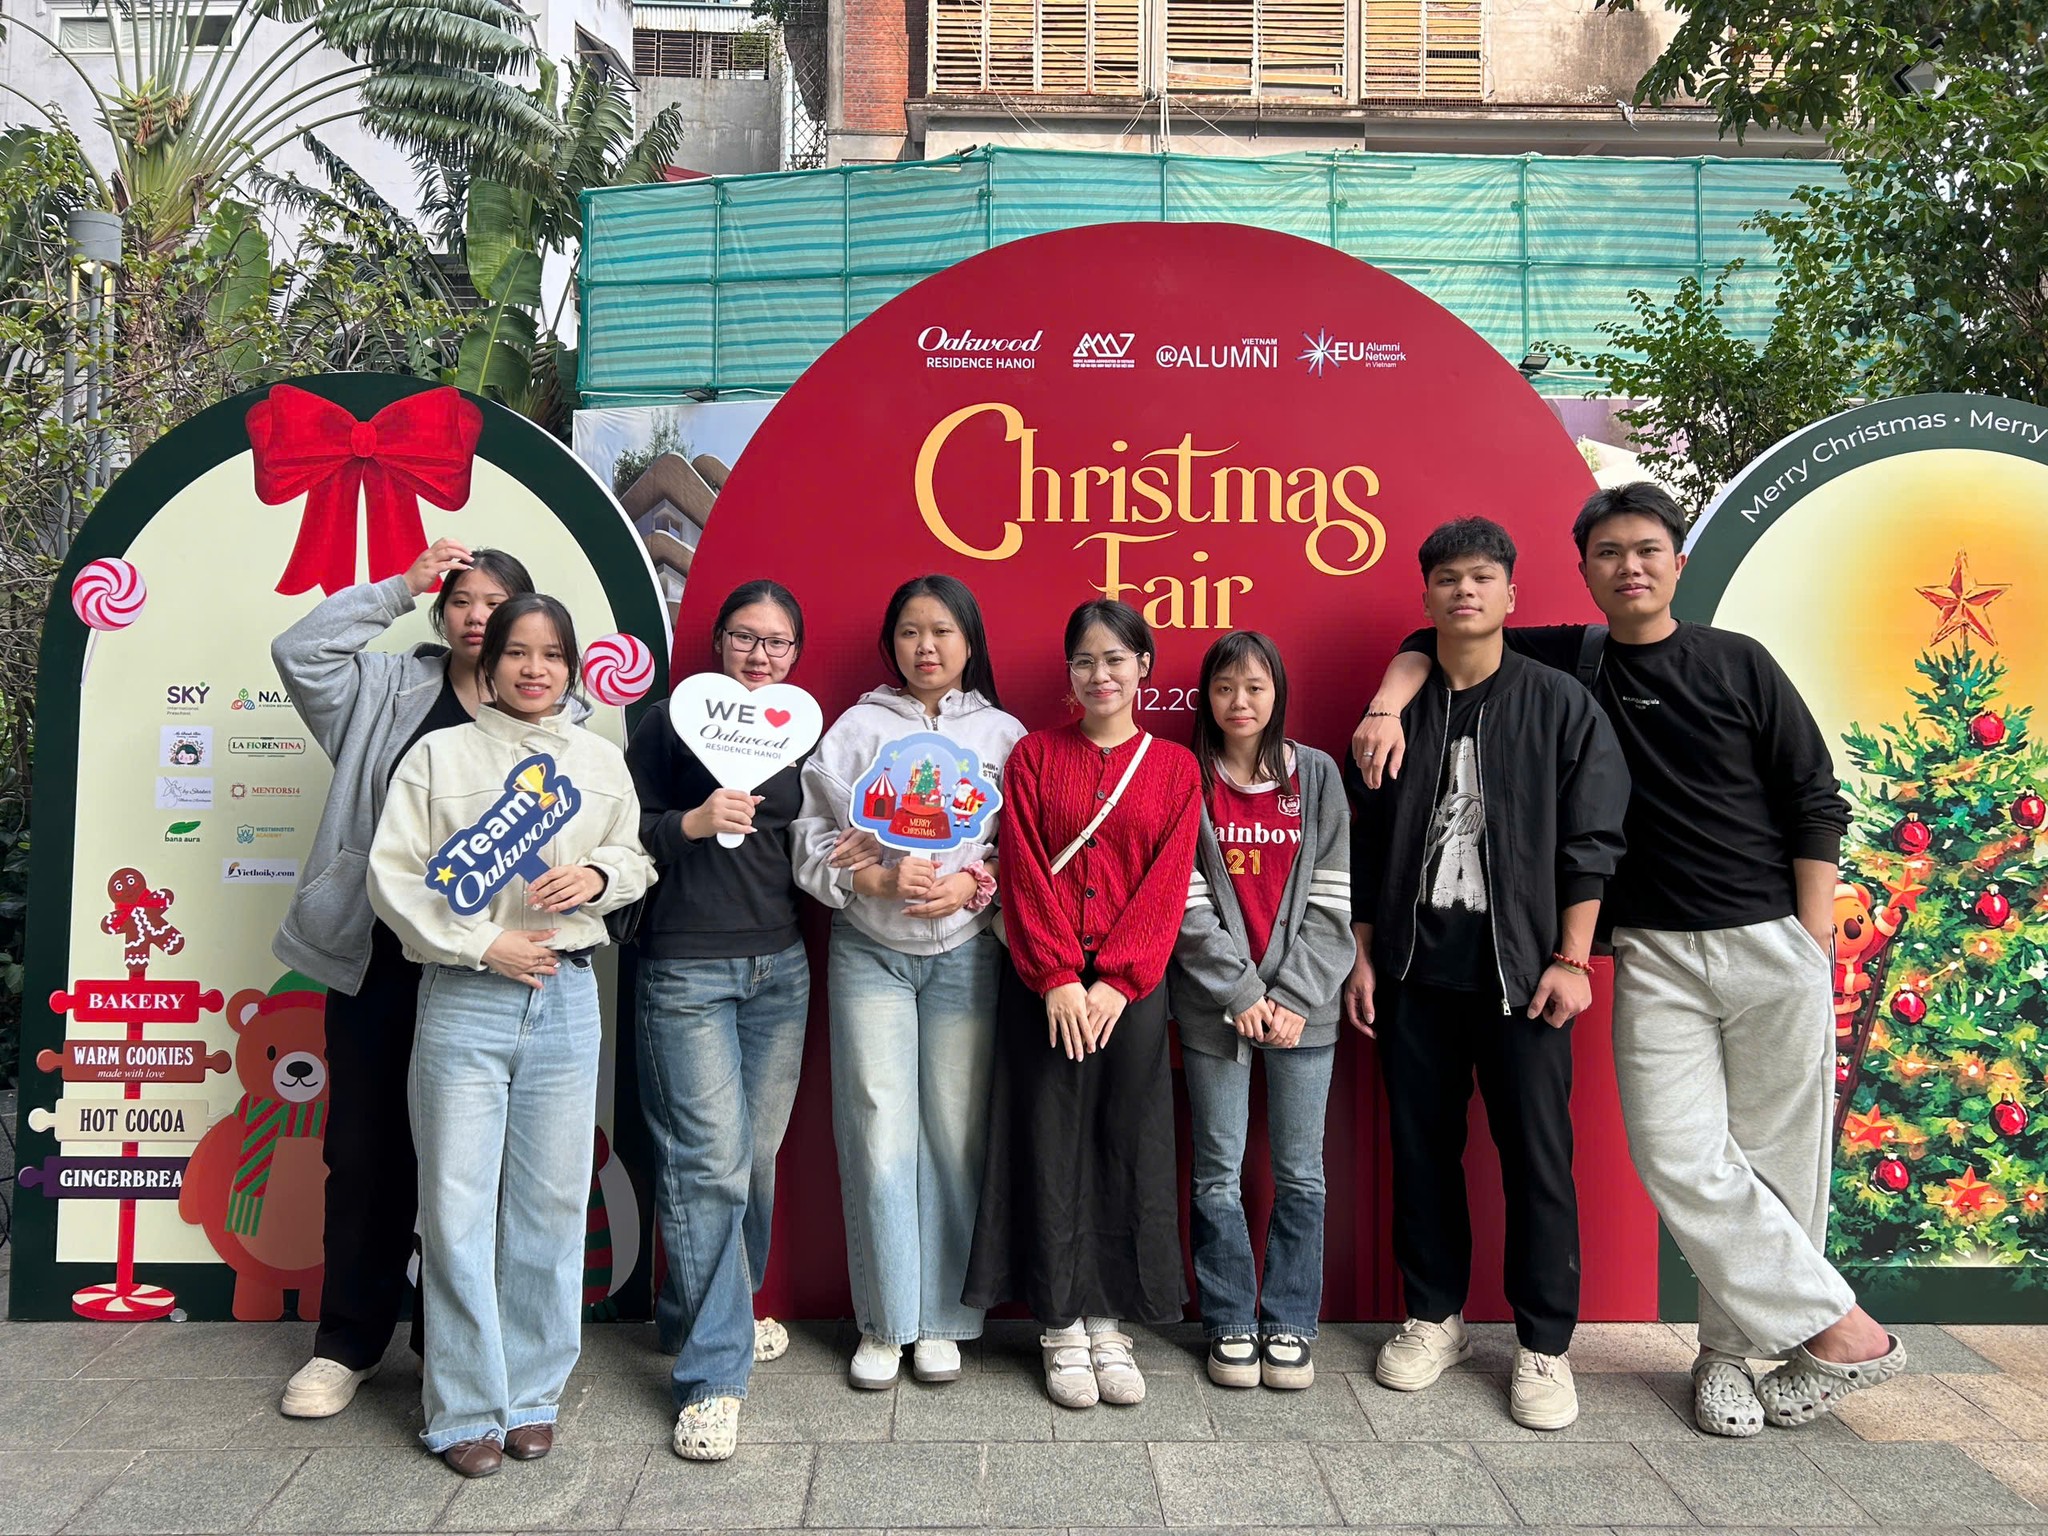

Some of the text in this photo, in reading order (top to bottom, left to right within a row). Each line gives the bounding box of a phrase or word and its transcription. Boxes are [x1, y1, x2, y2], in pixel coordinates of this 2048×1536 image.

[917, 326, 1043, 352] Oakwood
[1366, 342, 1400, 352] Alumni
[1334, 341, 1364, 361] EU
[1365, 351, 1407, 361] Network
[926, 357, 1035, 369] RESIDENCE HANOI
[1969, 408, 2048, 445] Merry
[1740, 412, 1947, 524] Merry Christmas
[914, 402, 1387, 576] Christmas
[1072, 530, 1254, 630] Fair
[166, 682, 211, 705] SKY
[705, 699, 757, 725] WE
[232, 741, 302, 750] LA FIORENTINA
[700, 724, 790, 750] Oakwood
[705, 742, 782, 760] RESIDENCE HANOI
[252, 787, 301, 795] MENTORS14
[446, 791, 536, 868] Team
[902, 825, 936, 837] CHRISTMAS
[910, 818, 931, 828] MERRY
[1211, 820, 1301, 845] ainbow
[454, 784, 572, 909] Oakwood
[1226, 848, 1260, 875] 21
[88, 993, 186, 1010] BAKERY
[73, 1046, 194, 1066] WARM COOKIES
[97, 1068, 165, 1078] made with love
[79, 1108, 185, 1132] HOT COCOA
[59, 1169, 182, 1188] GINGERBREA
